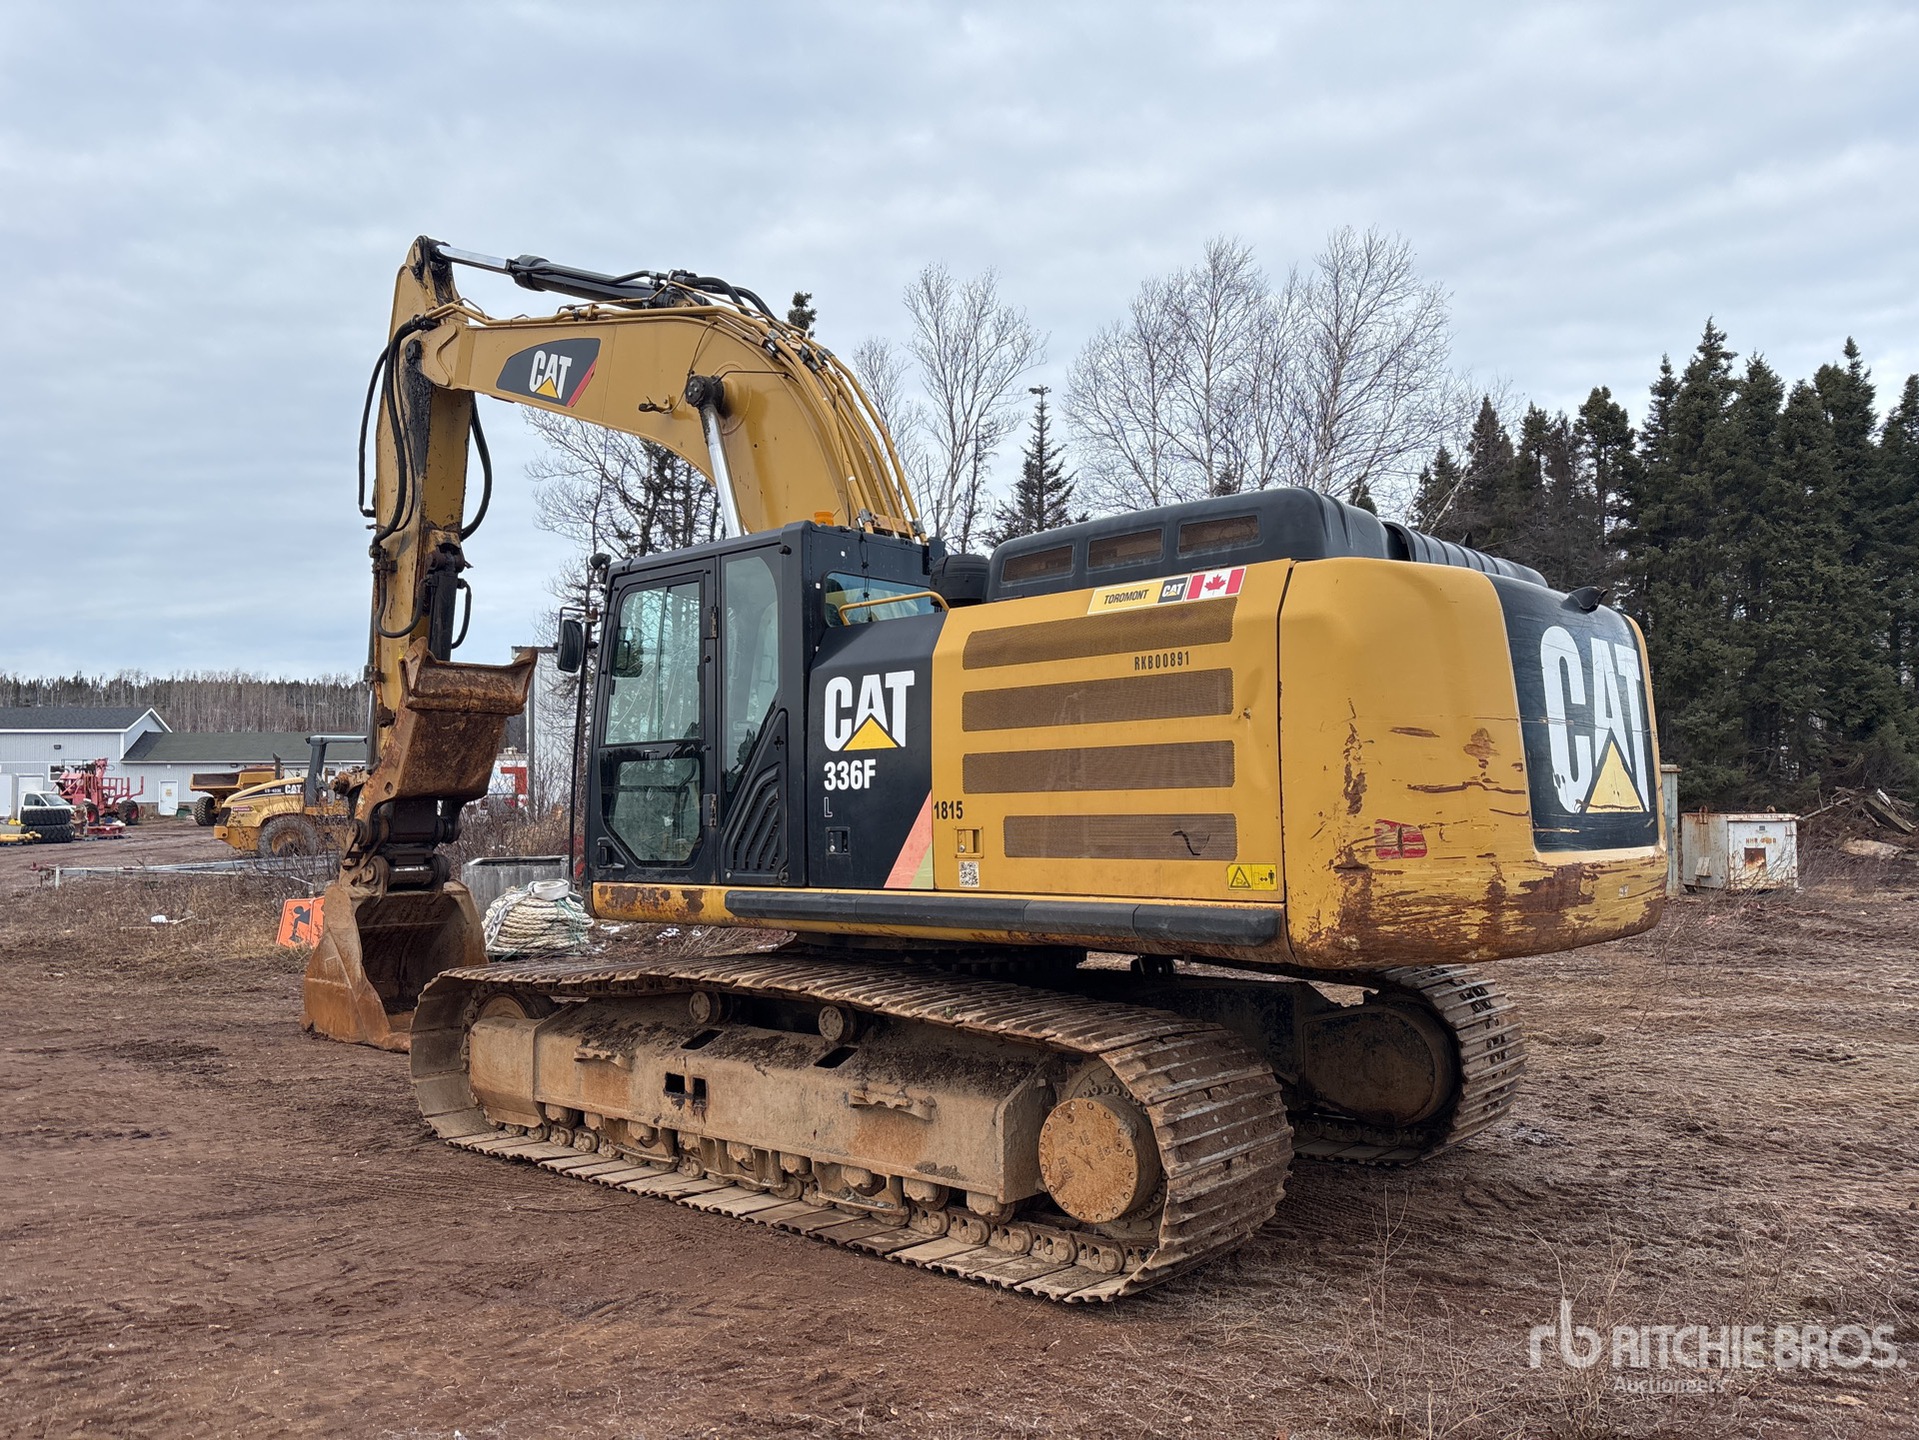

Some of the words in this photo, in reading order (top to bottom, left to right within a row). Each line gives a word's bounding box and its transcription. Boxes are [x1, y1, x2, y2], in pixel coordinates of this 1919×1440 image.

[529, 350, 572, 399] CAT
[1104, 589, 1149, 604] TOROMONT
[1162, 583, 1185, 597] CAT
[1134, 651, 1190, 670] RKB00891
[824, 670, 915, 752] CAT
[1540, 626, 1650, 814] CAT
[824, 759, 876, 791] 336F
[285, 784, 302, 794] CAT
[823, 797, 833, 818] L
[934, 801, 964, 819] 1815
